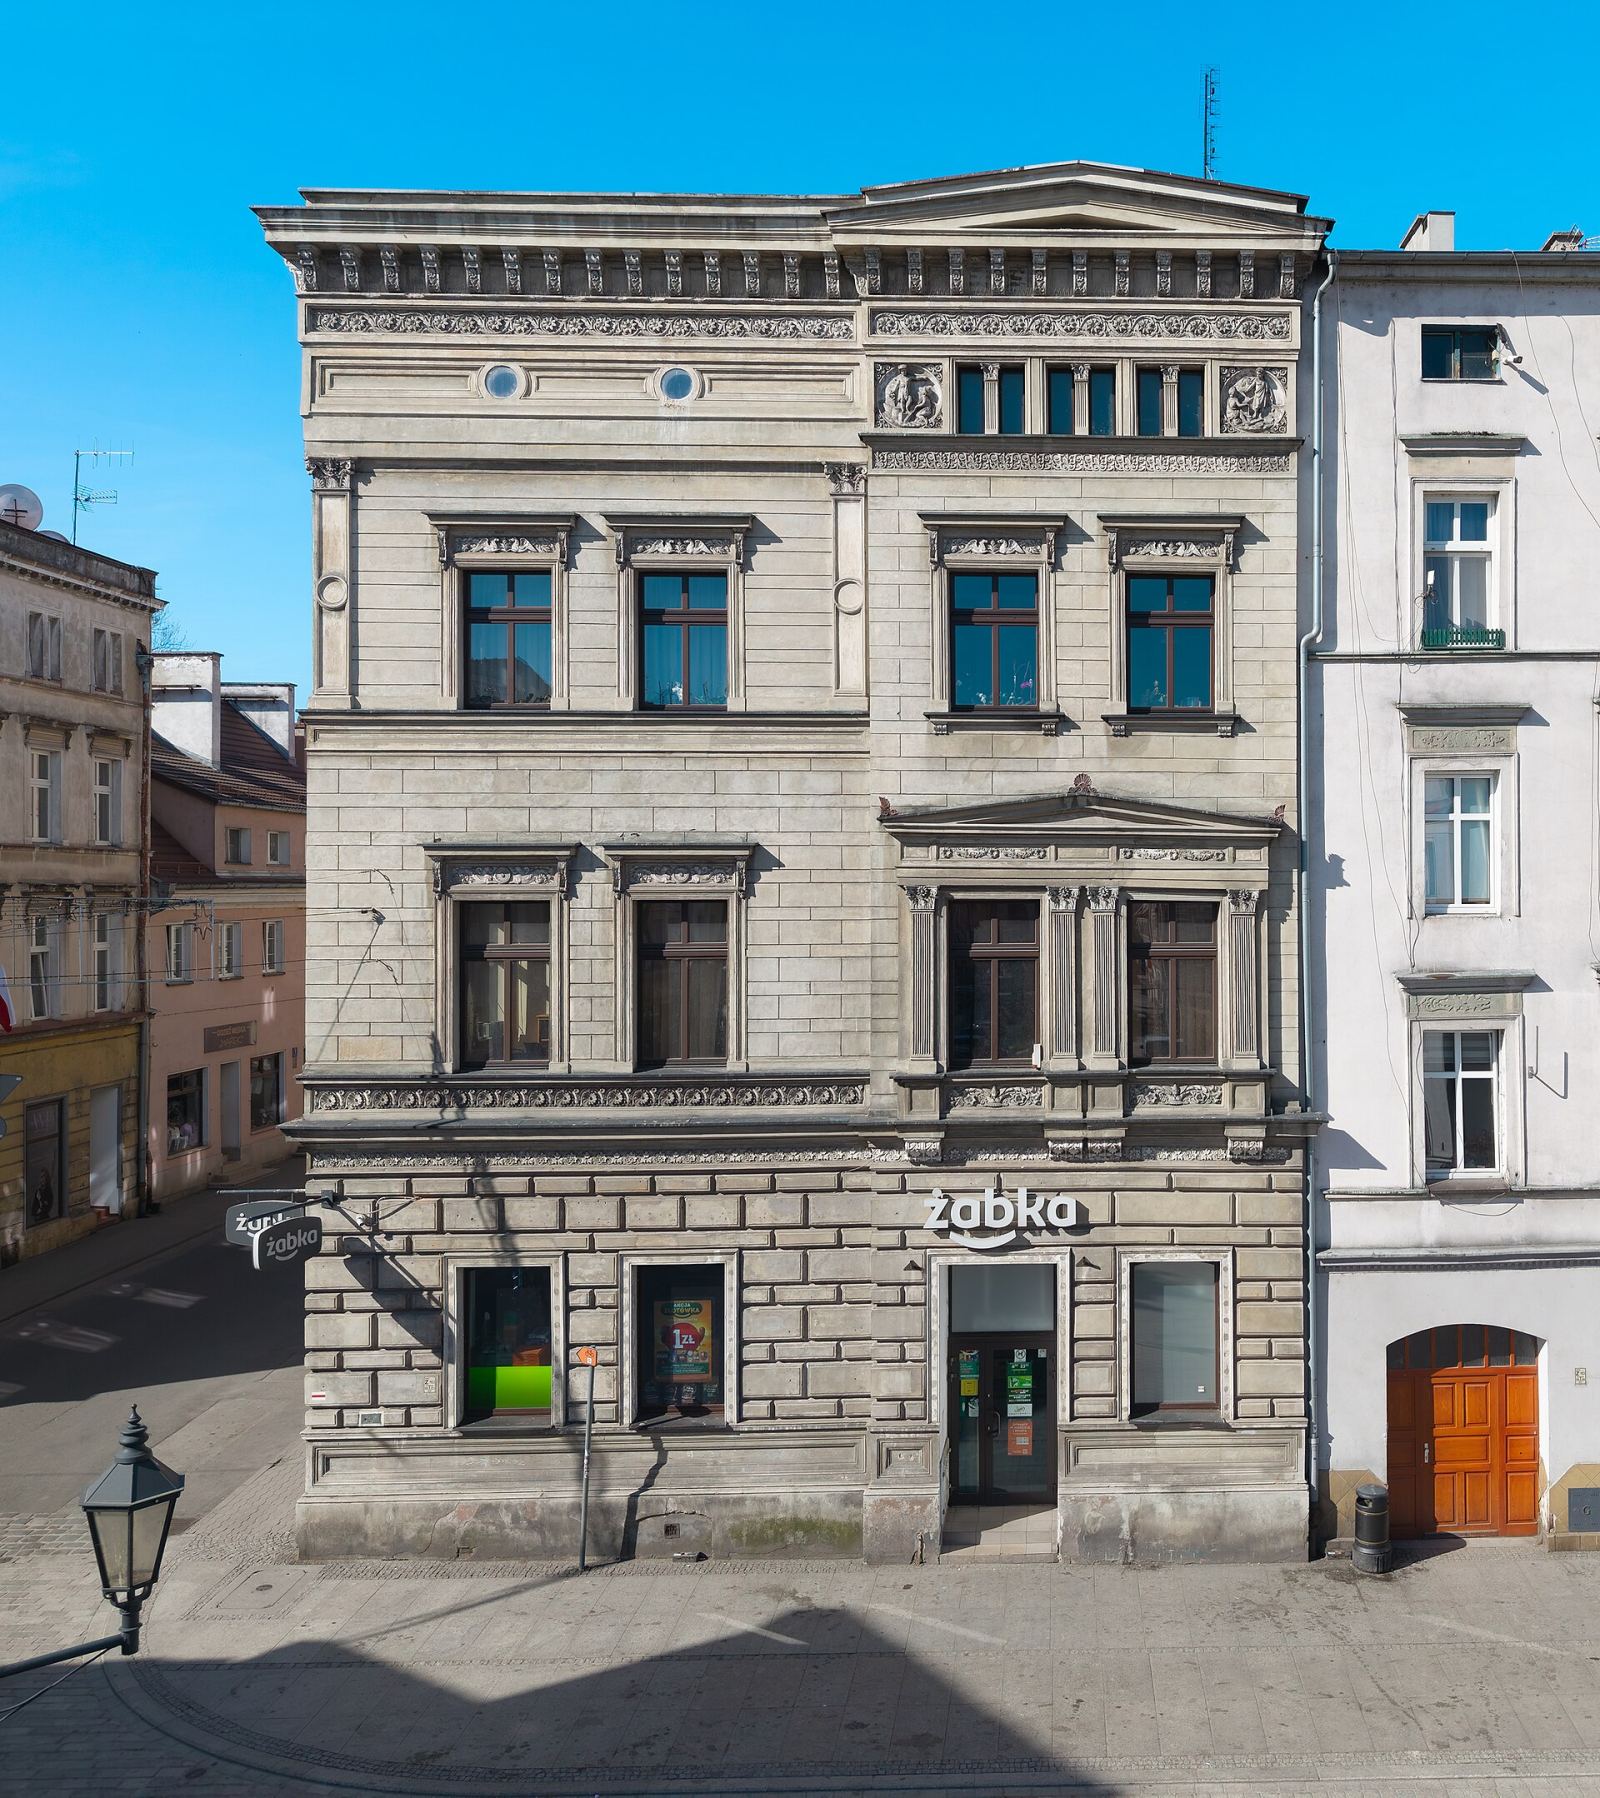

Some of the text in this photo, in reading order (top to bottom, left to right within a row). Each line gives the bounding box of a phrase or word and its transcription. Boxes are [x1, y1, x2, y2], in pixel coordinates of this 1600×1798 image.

[923, 1187, 1077, 1229] żabka
[266, 1229, 318, 1257] żabka
[673, 1329, 684, 1349] 1
